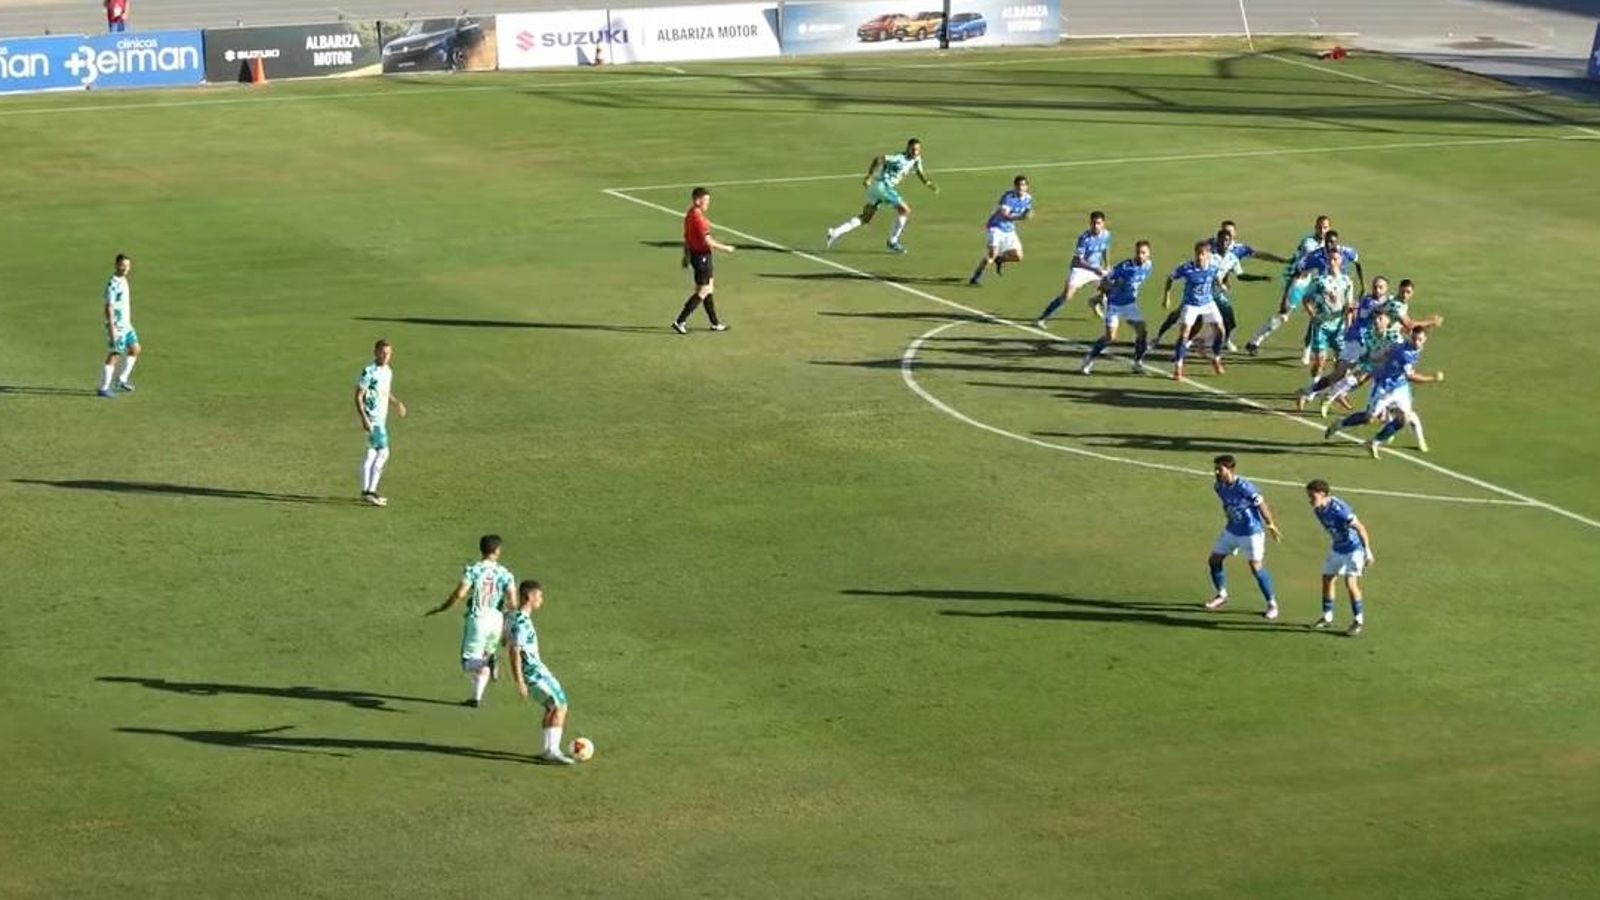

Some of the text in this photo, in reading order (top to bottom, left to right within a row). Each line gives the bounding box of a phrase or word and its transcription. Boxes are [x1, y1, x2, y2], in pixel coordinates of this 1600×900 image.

[541, 29, 629, 47] SUZUKI
[657, 24, 758, 42] ALBARIZA MOTOR
[305, 34, 361, 50] ALBARIZA
[313, 51, 353, 66] MOTOR
